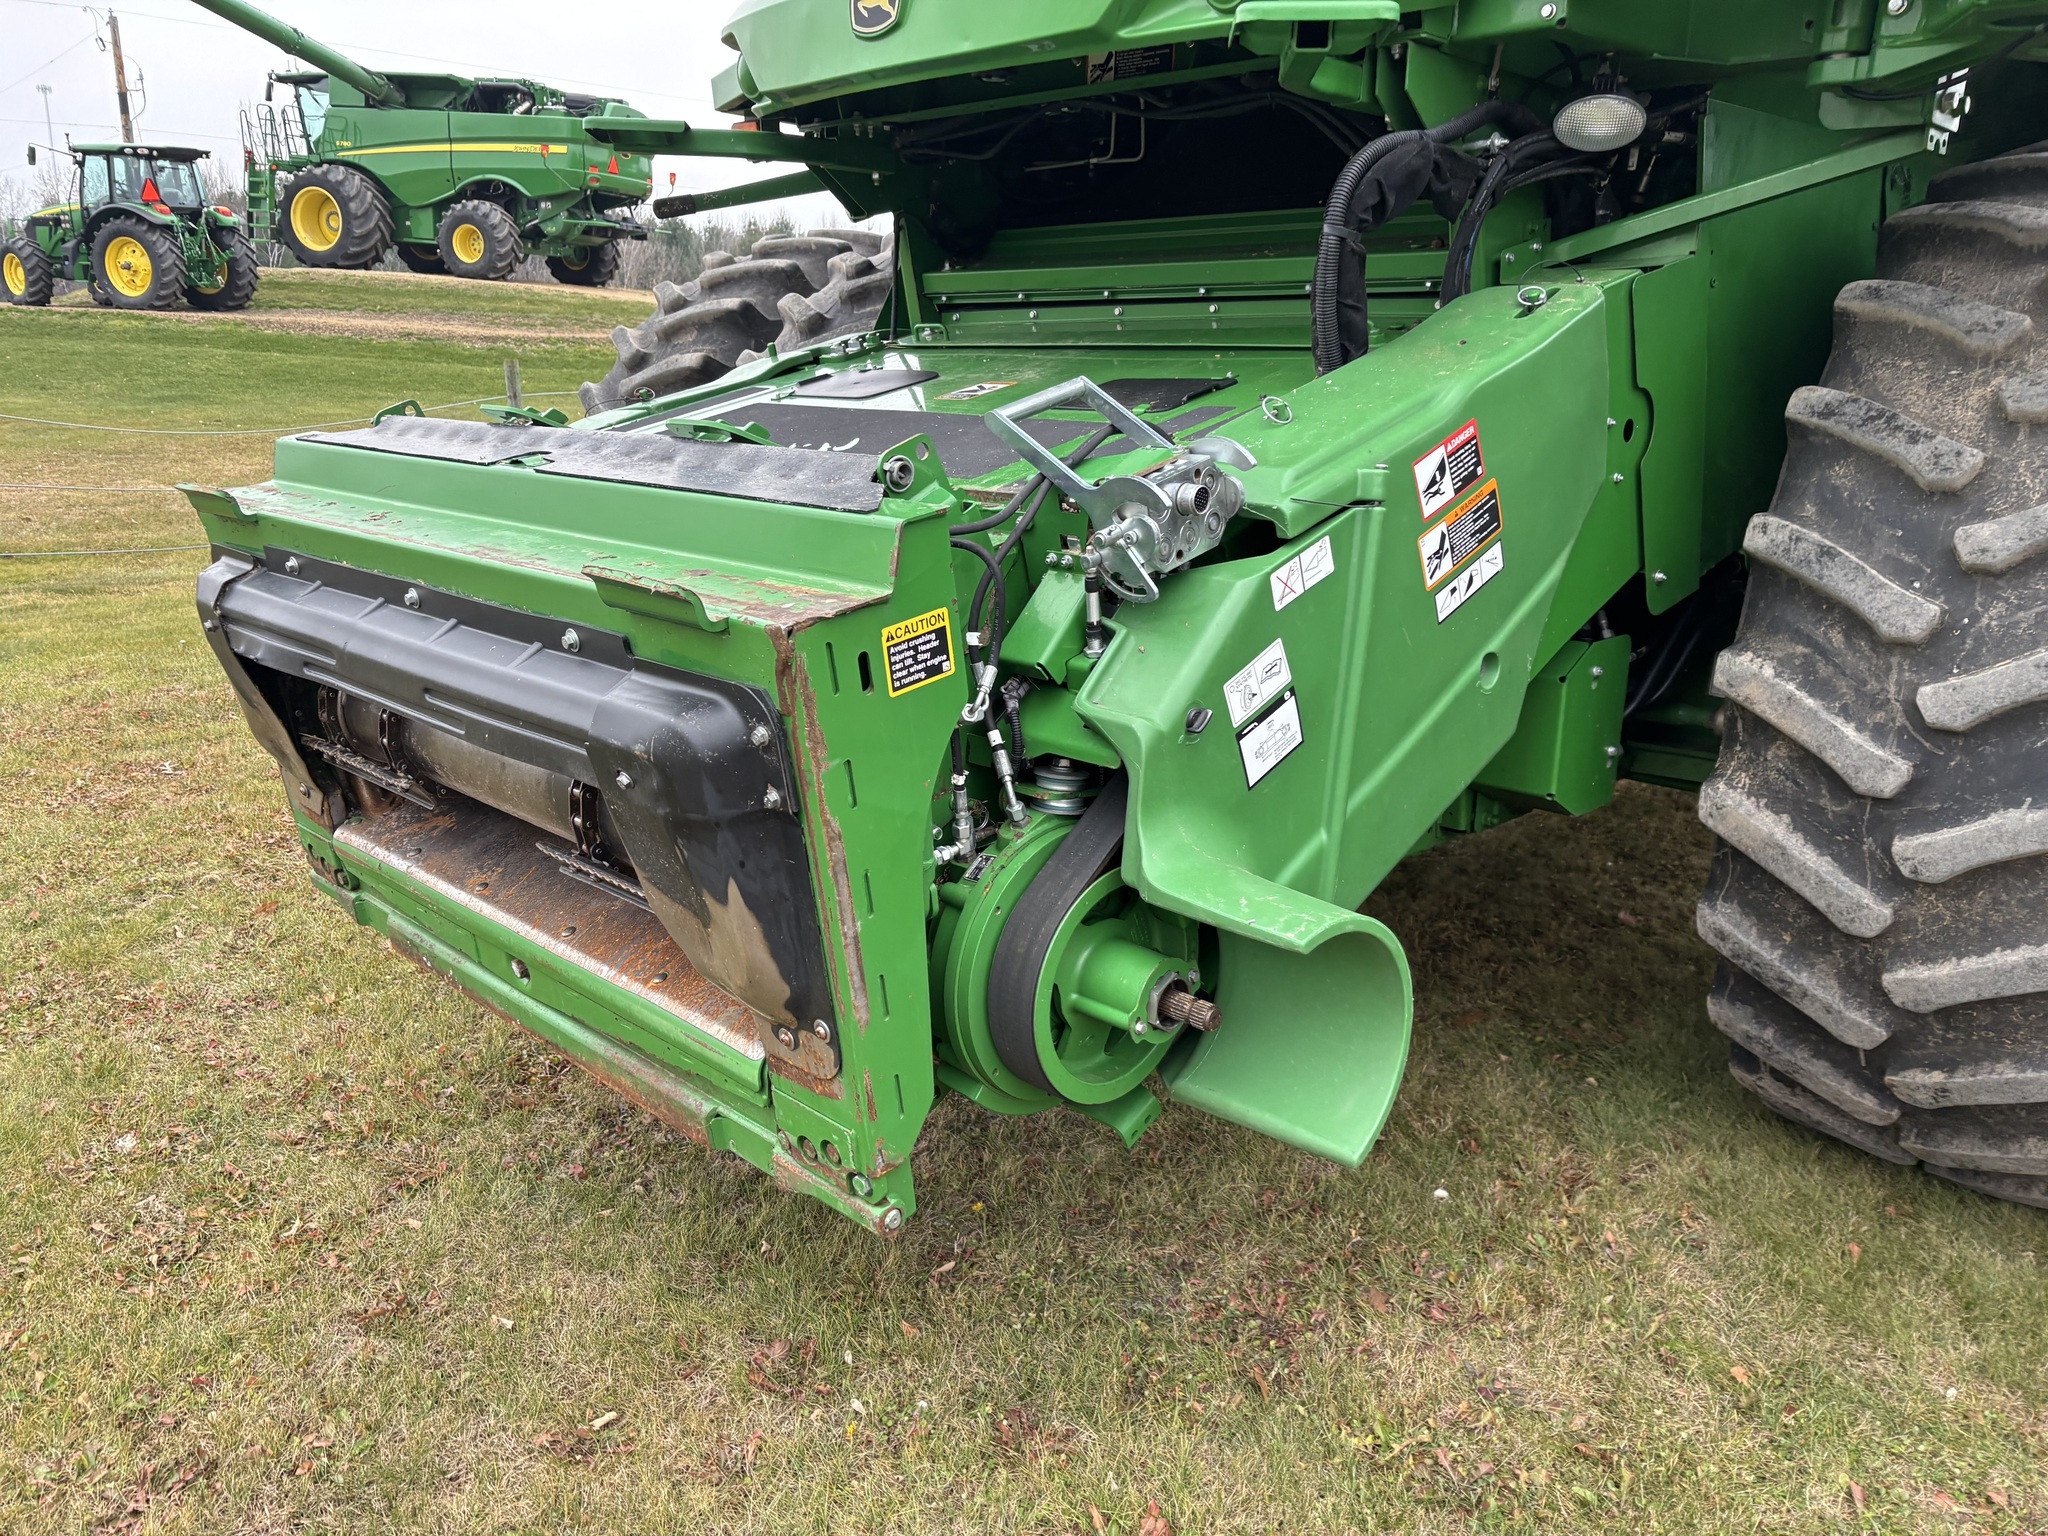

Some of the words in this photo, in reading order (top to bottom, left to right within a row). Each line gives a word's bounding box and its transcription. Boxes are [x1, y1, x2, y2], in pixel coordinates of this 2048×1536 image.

[1451, 425, 1475, 447] DANGER
[1459, 490, 1484, 512] WARNING
[895, 612, 945, 639] CAUTION
[890, 641, 908, 654] Avoid
[909, 632, 936, 647] crushing
[890, 649, 915, 662] injuries.
[918, 639, 940, 652] Header
[892, 662, 904, 671] can
[904, 656, 915, 667] tilt.
[917, 651, 931, 662] Stay
[893, 668, 908, 679] clear
[909, 661, 926, 673] when
[926, 653, 947, 666] engine
[894, 679, 901, 688] is
[901, 671, 927, 685] running.
